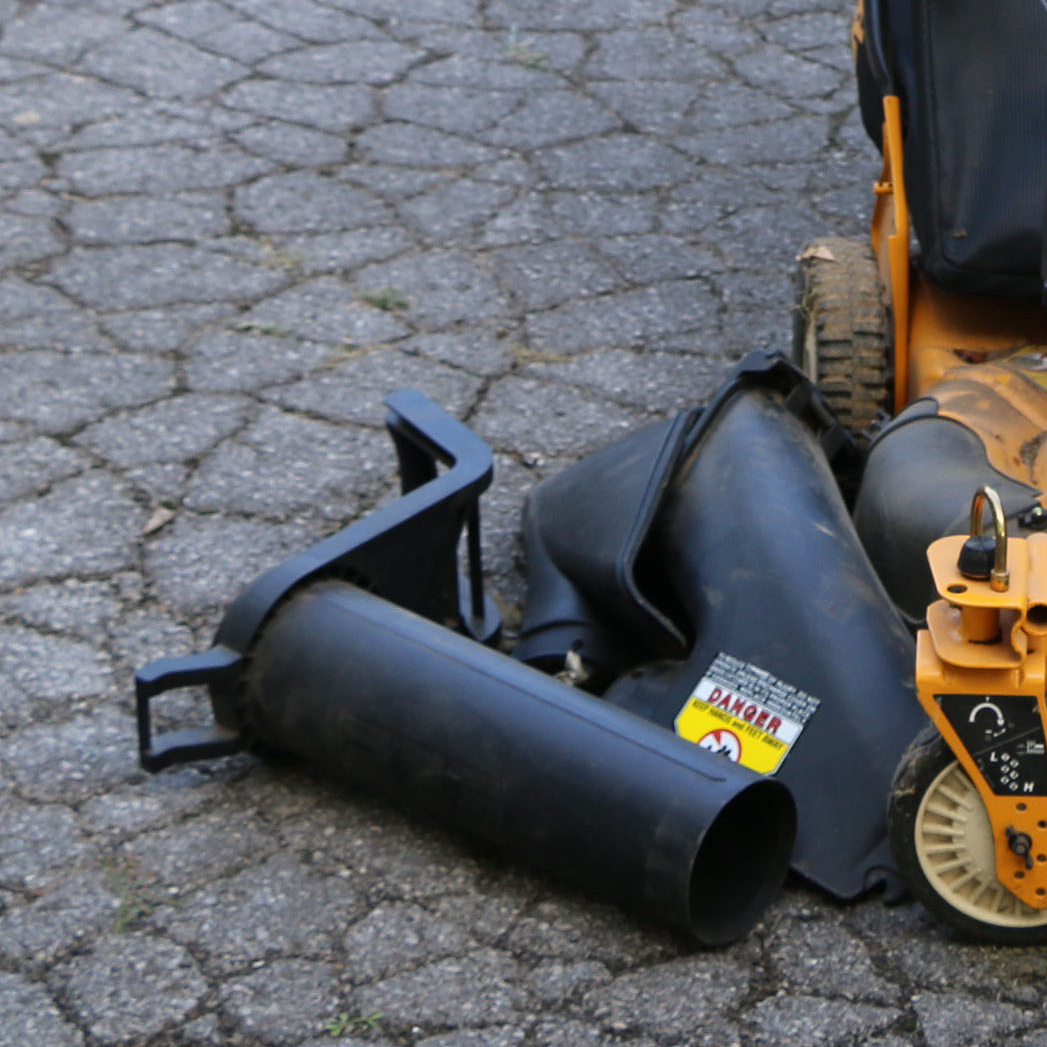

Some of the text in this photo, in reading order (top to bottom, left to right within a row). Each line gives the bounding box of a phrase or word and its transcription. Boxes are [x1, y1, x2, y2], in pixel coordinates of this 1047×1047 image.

[708, 688, 782, 735] DANGER
[990, 752, 998, 762] L
[1023, 782, 1034, 793] H
